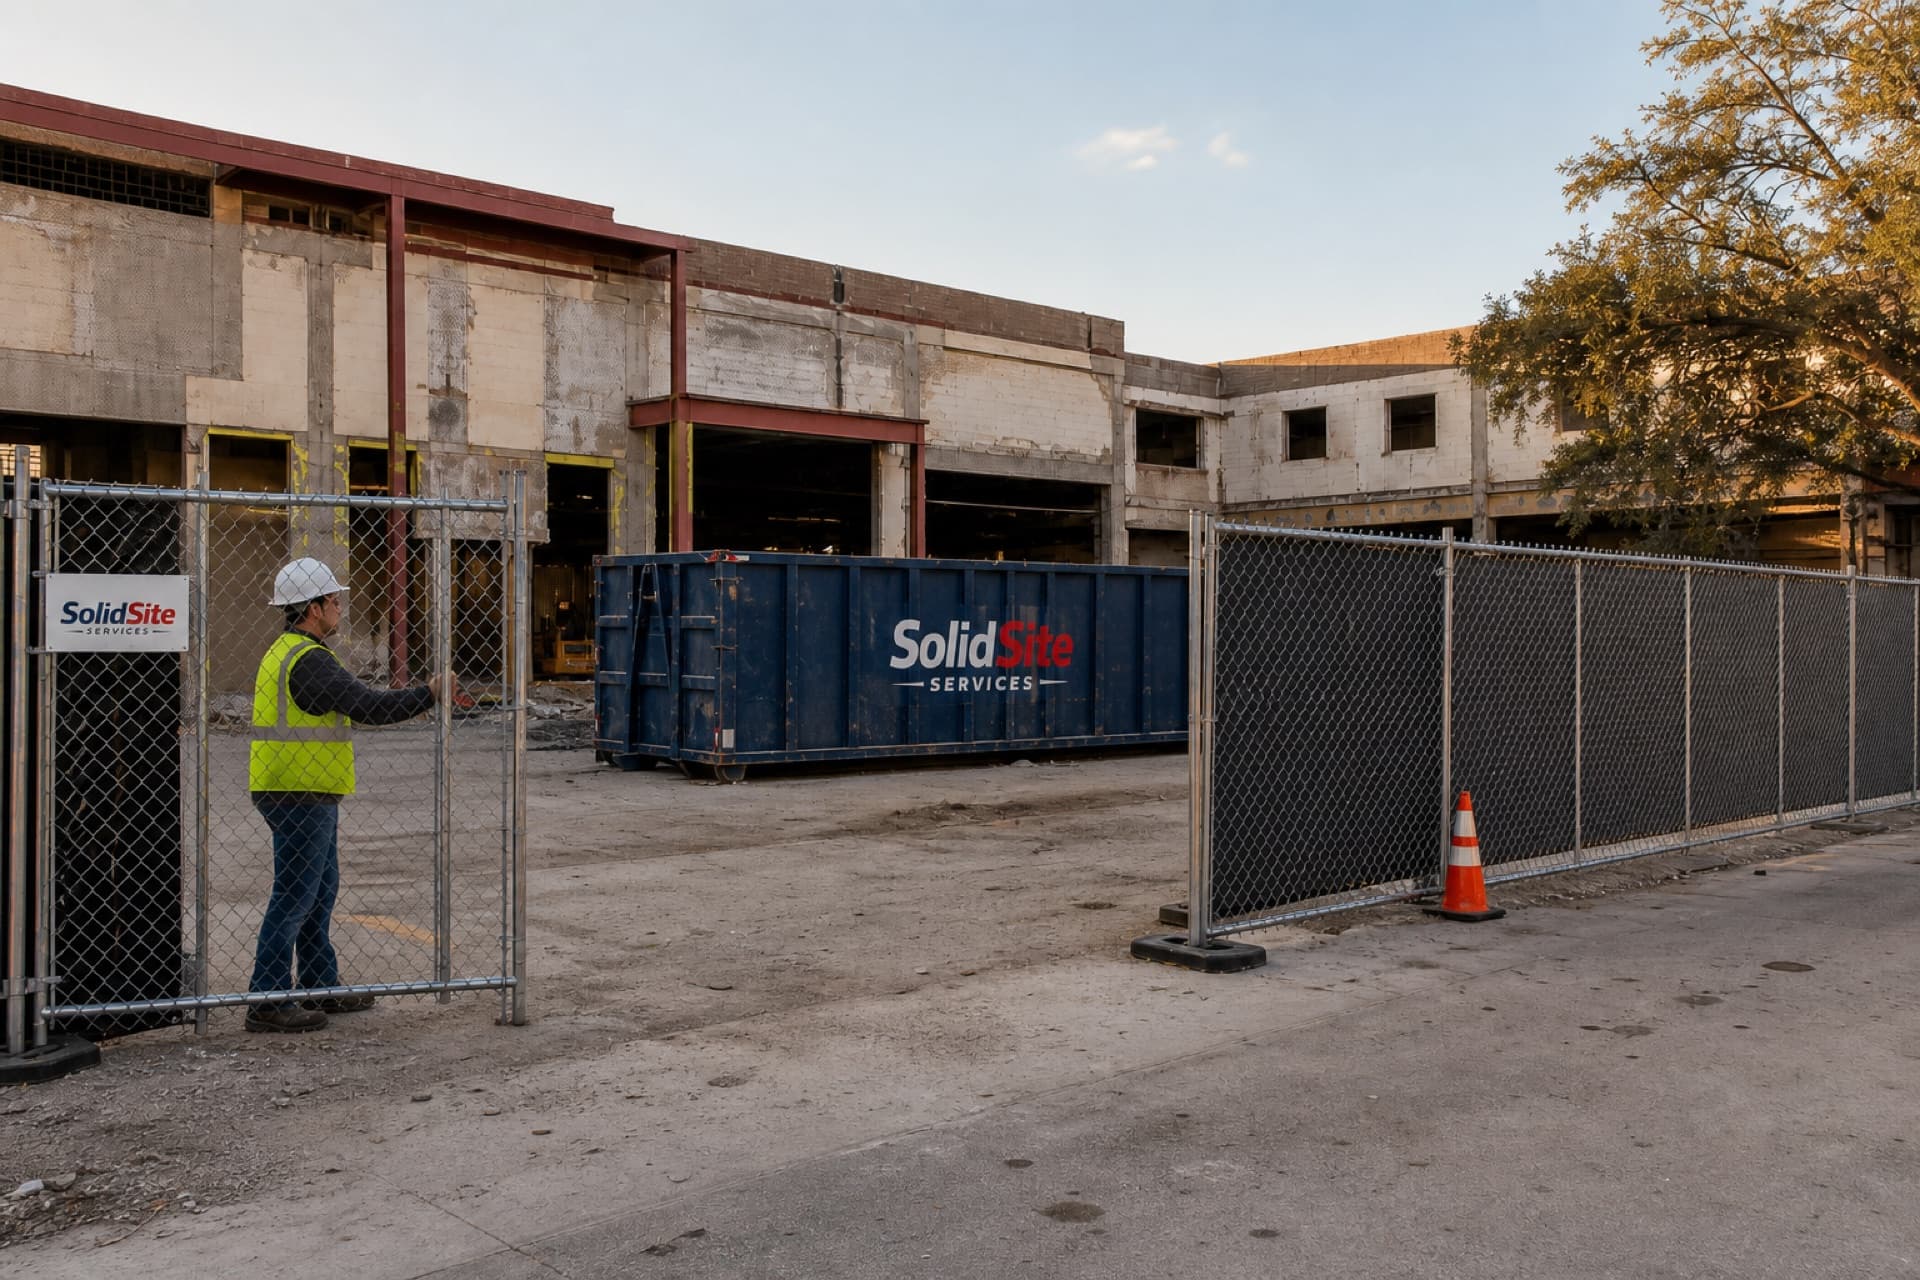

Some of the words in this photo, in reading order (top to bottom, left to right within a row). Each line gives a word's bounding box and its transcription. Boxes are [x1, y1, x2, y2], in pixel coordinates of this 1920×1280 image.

[61, 601, 176, 625] SolidSite
[86, 627, 149, 635] SERVICES
[889, 619, 1074, 669] SolidSite
[930, 676, 1033, 691] SERVICES
